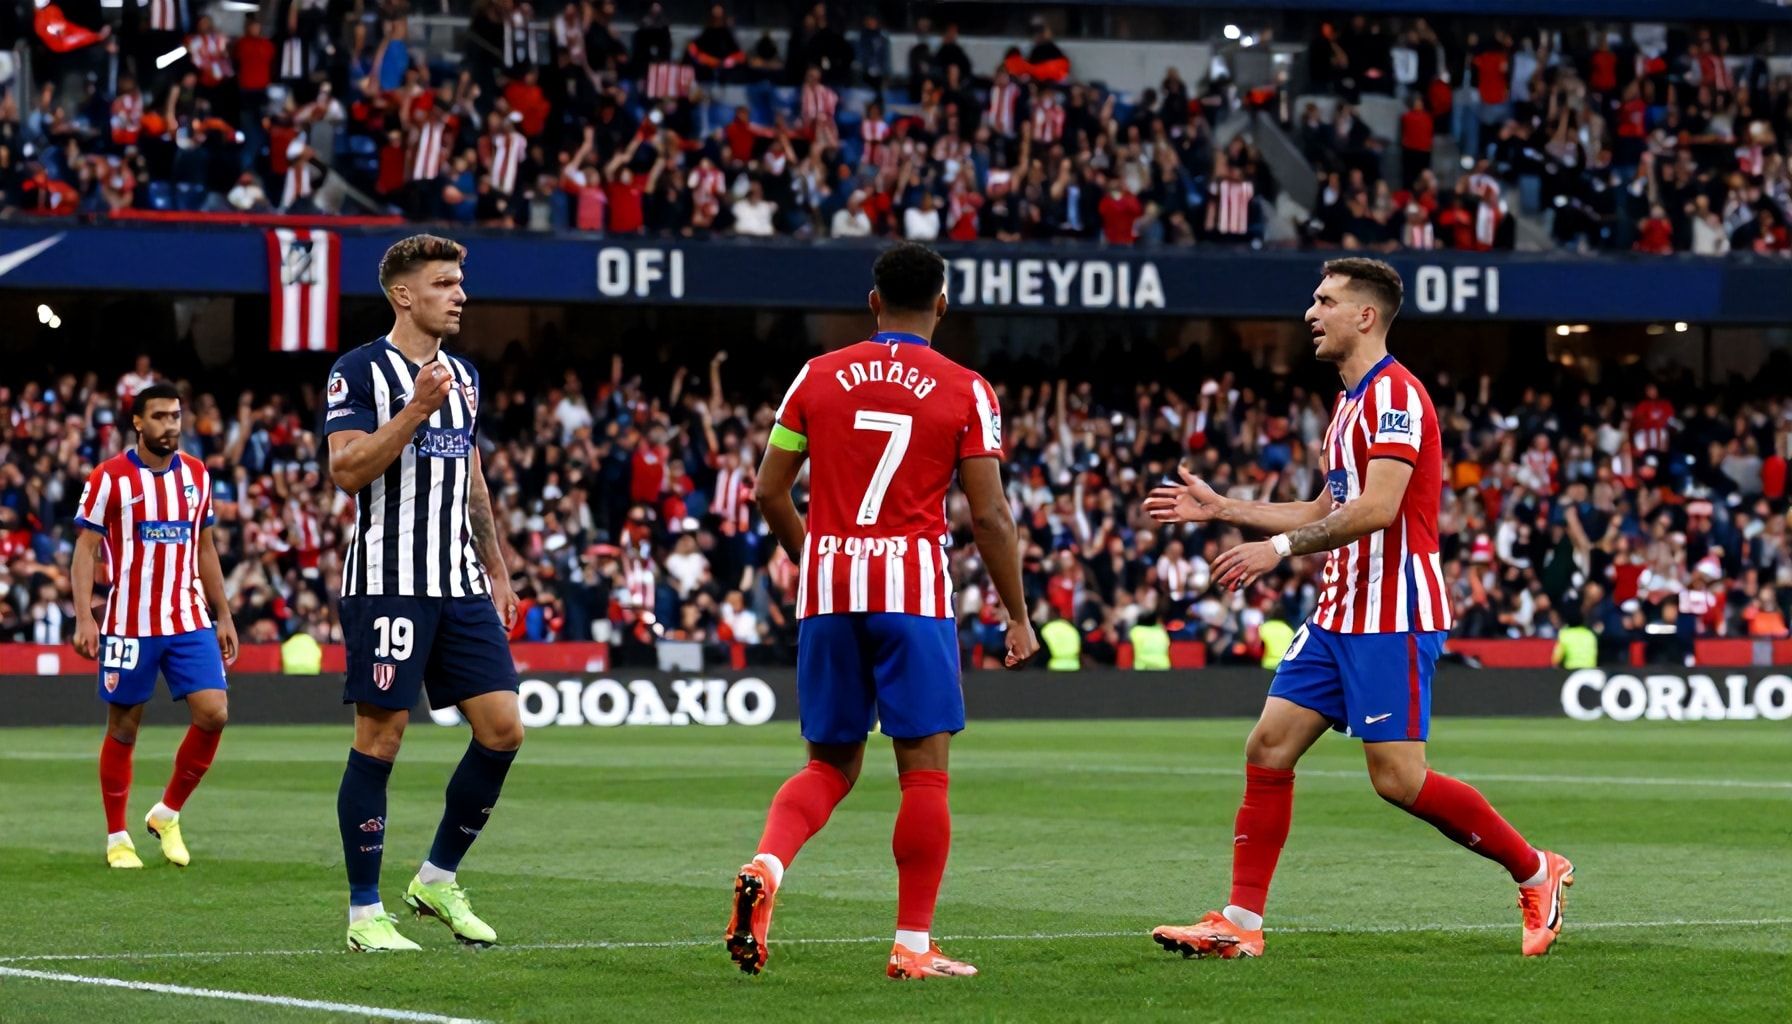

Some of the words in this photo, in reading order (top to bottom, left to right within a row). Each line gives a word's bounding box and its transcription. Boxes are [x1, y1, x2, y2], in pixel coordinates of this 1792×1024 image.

[597, 247, 684, 298] OFI
[1415, 264, 1499, 313] OFI
[853, 410, 913, 526] 7
[373, 616, 414, 661] 19
